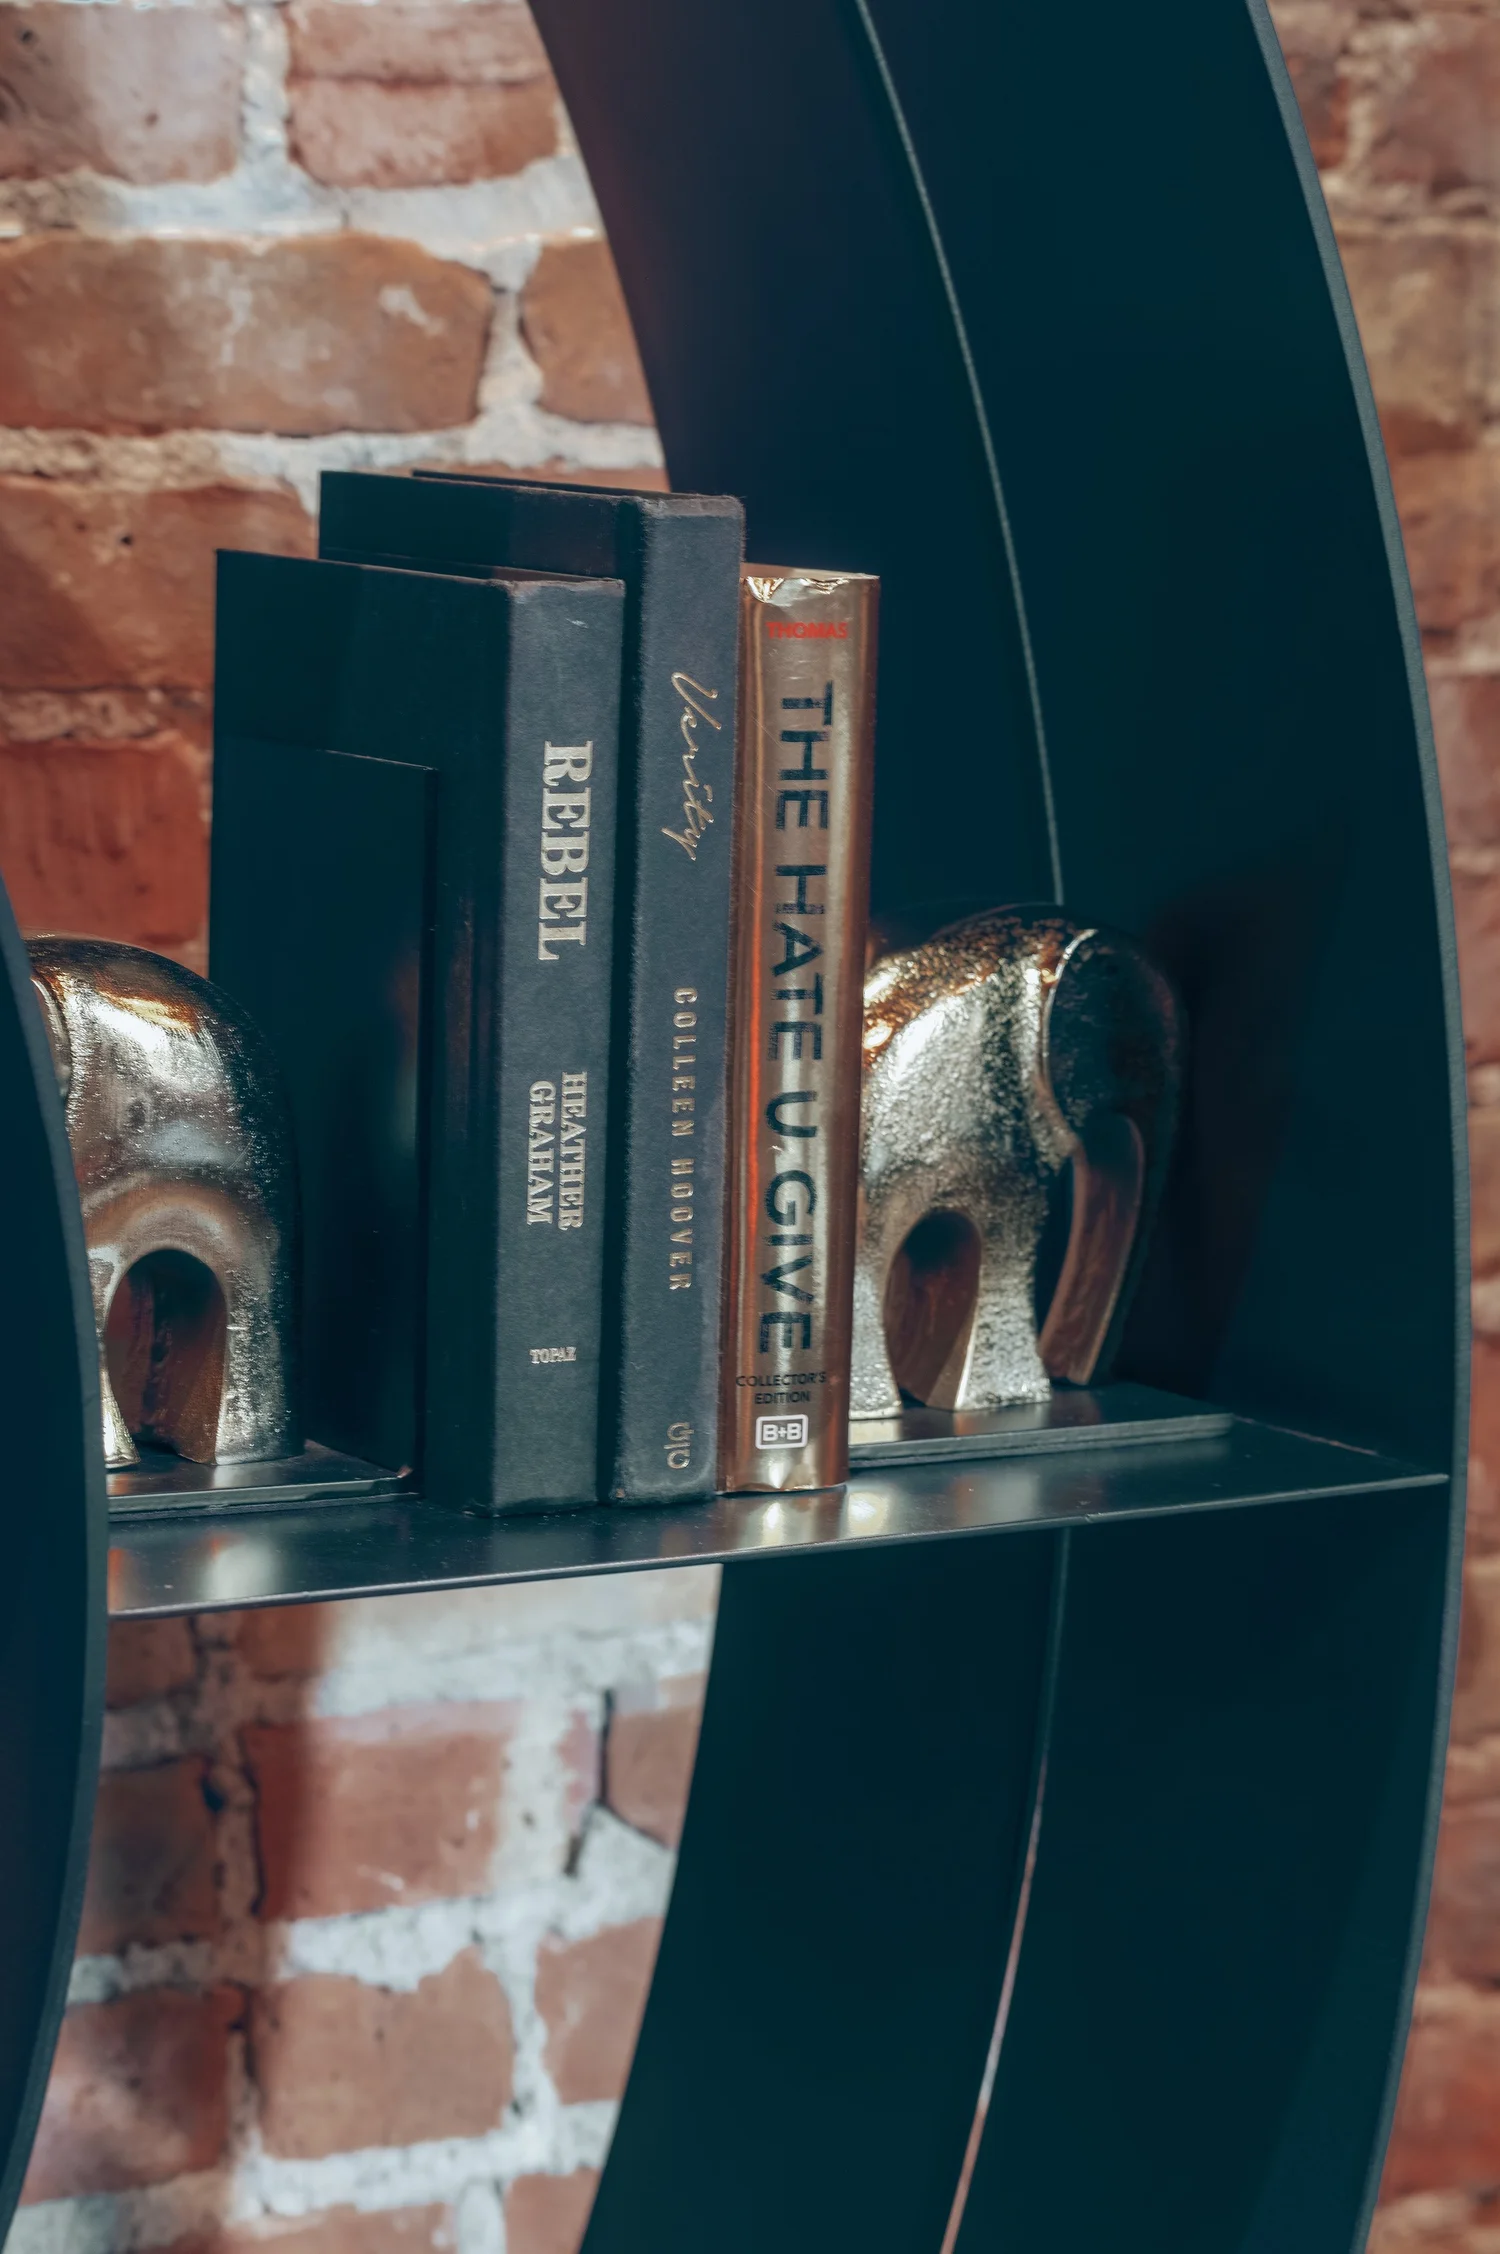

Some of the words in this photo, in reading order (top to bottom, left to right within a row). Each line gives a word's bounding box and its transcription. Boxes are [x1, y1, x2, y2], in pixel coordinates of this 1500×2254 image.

[765, 621, 848, 639] THOMAS
[662, 671, 722, 861] Verity
[775, 680, 835, 831] THE
[537, 740, 594, 961] REBEL
[770, 864, 827, 1061] HATE
[672, 986, 698, 1136] COLLEEN
[765, 1091, 819, 1139] U
[526, 1080, 556, 1226] GRAHAM
[557, 1071, 588, 1231] HEATHER
[668, 1158, 695, 1290] HOOVER
[758, 1169, 818, 1353] GIVE
[529, 1346, 577, 1364] TOPAZ
[735, 1371, 827, 1387] COLLECTOR'S
[754, 1391, 811, 1405] EDITION
